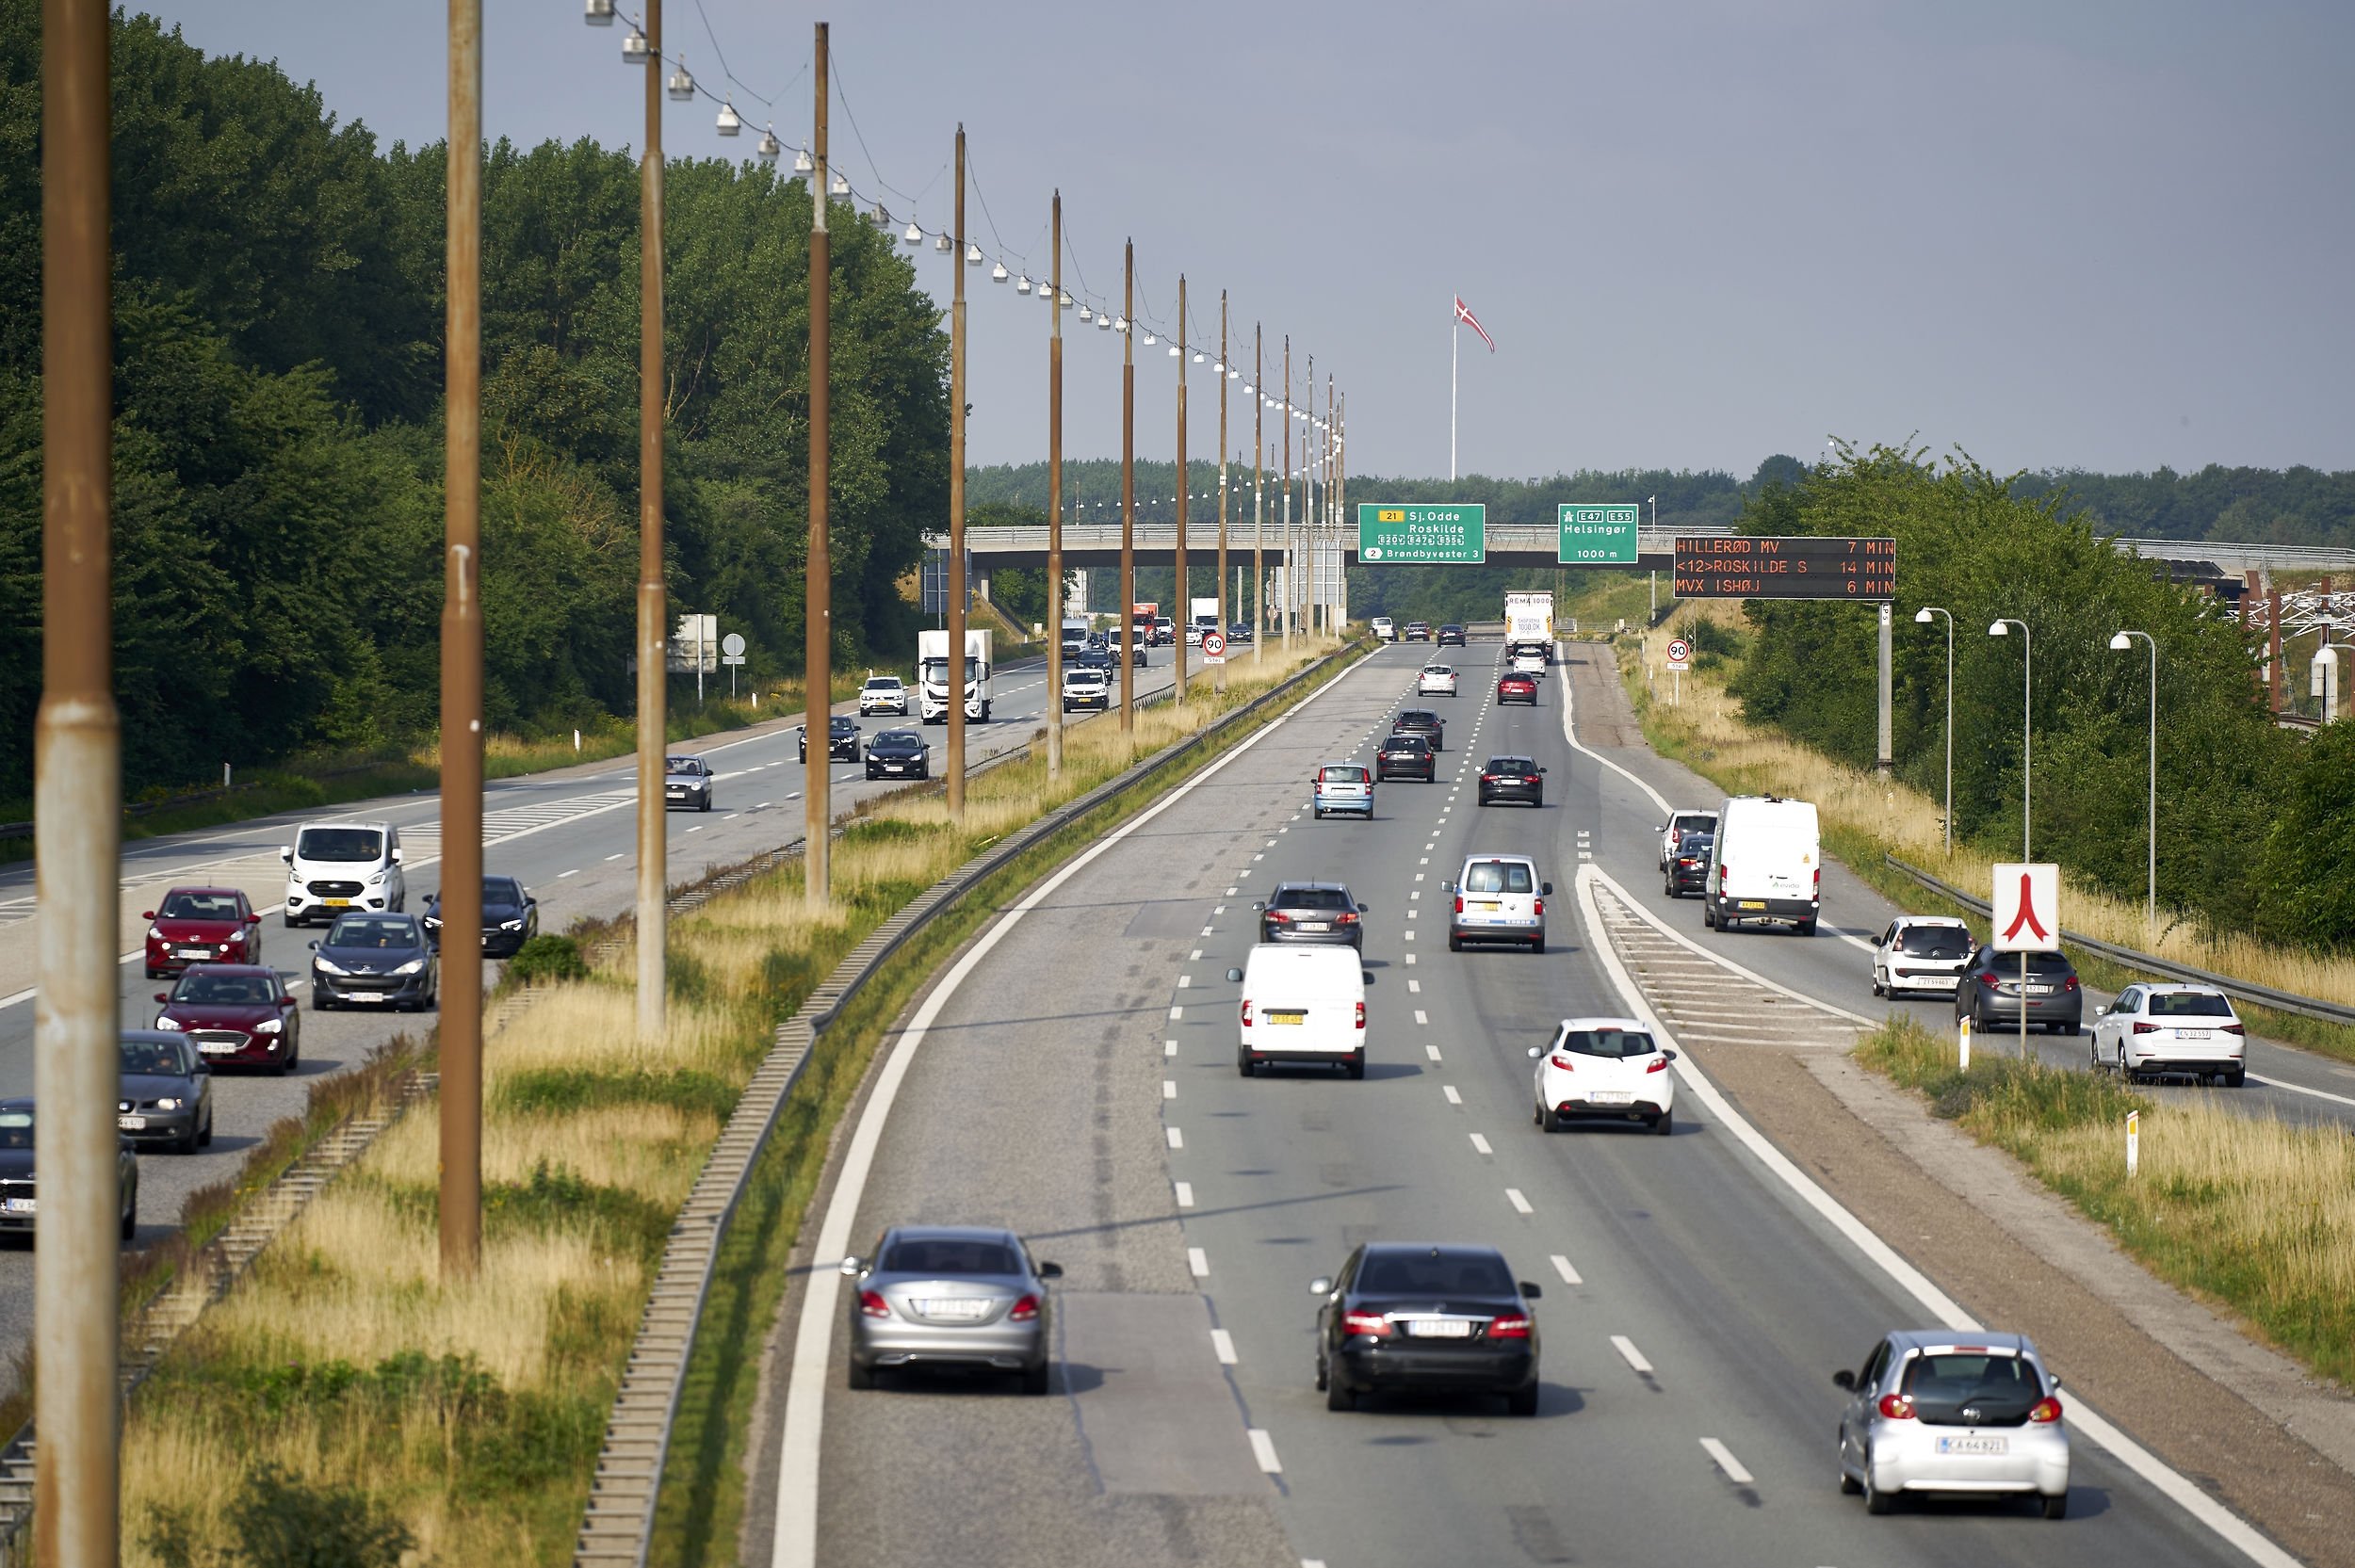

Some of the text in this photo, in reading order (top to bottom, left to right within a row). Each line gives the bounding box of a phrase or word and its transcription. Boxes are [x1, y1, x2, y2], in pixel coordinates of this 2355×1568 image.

[1580, 512, 1631, 521] E47 E55
[1409, 525, 1465, 533] Roskilde
[1564, 525, 1627, 535] Helsingør
[1676, 541, 1893, 555] HILLERØD MV 7 MIN
[1387, 549, 1468, 559] Brøndbyvester
[1472, 550, 1479, 558] 3
[1577, 549, 1605, 558] 1000
[1797, 560, 1808, 574] S
[1840, 561, 1857, 574] 14
[1866, 560, 1893, 574] MIN
[1676, 579, 1893, 593] MVX ISHØJ 6 MIN
[1207, 639, 1222, 649] 90
[1670, 646, 1685, 655] 90
